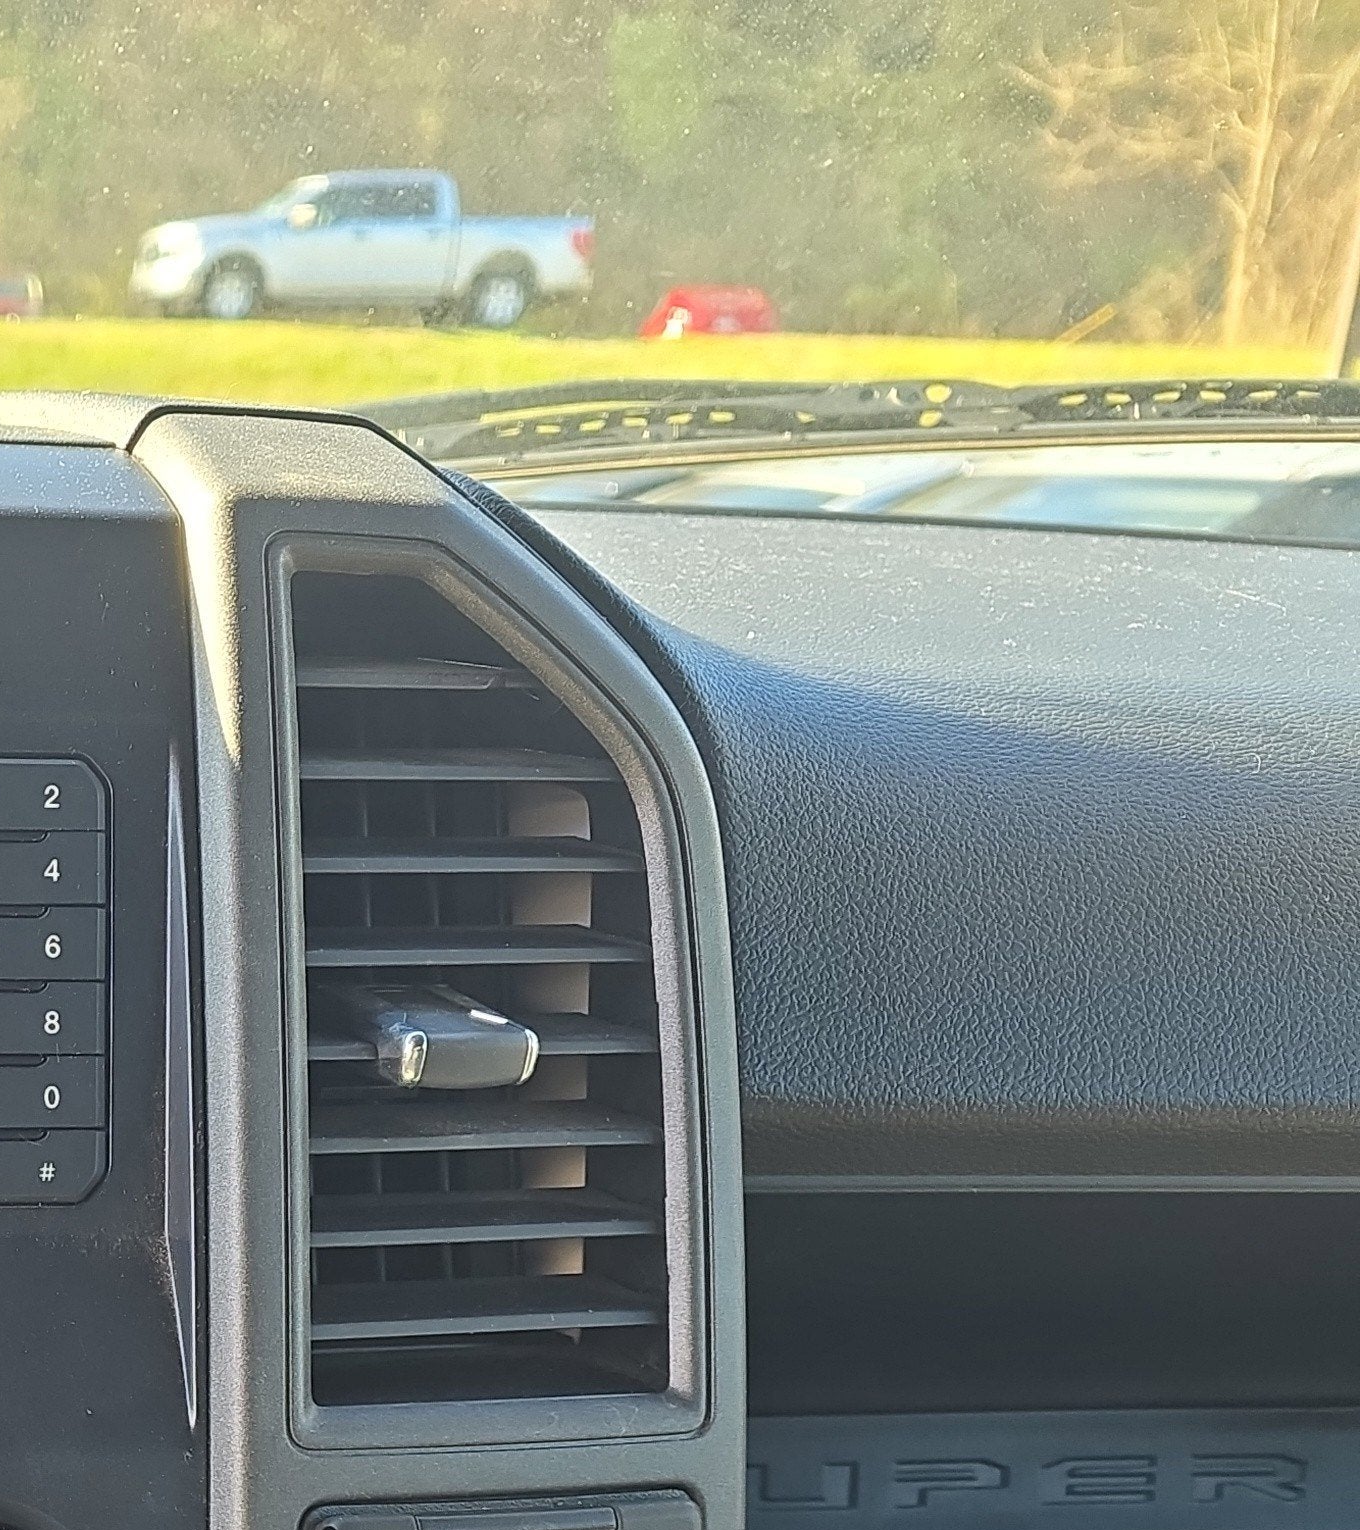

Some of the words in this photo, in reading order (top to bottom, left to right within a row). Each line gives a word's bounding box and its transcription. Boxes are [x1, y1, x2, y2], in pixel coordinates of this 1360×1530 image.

[43, 785, 60, 809] 2
[43, 859, 61, 883] 4
[44, 934, 62, 959] 6
[43, 1010, 61, 1035] 8
[43, 1086, 60, 1110] 0
